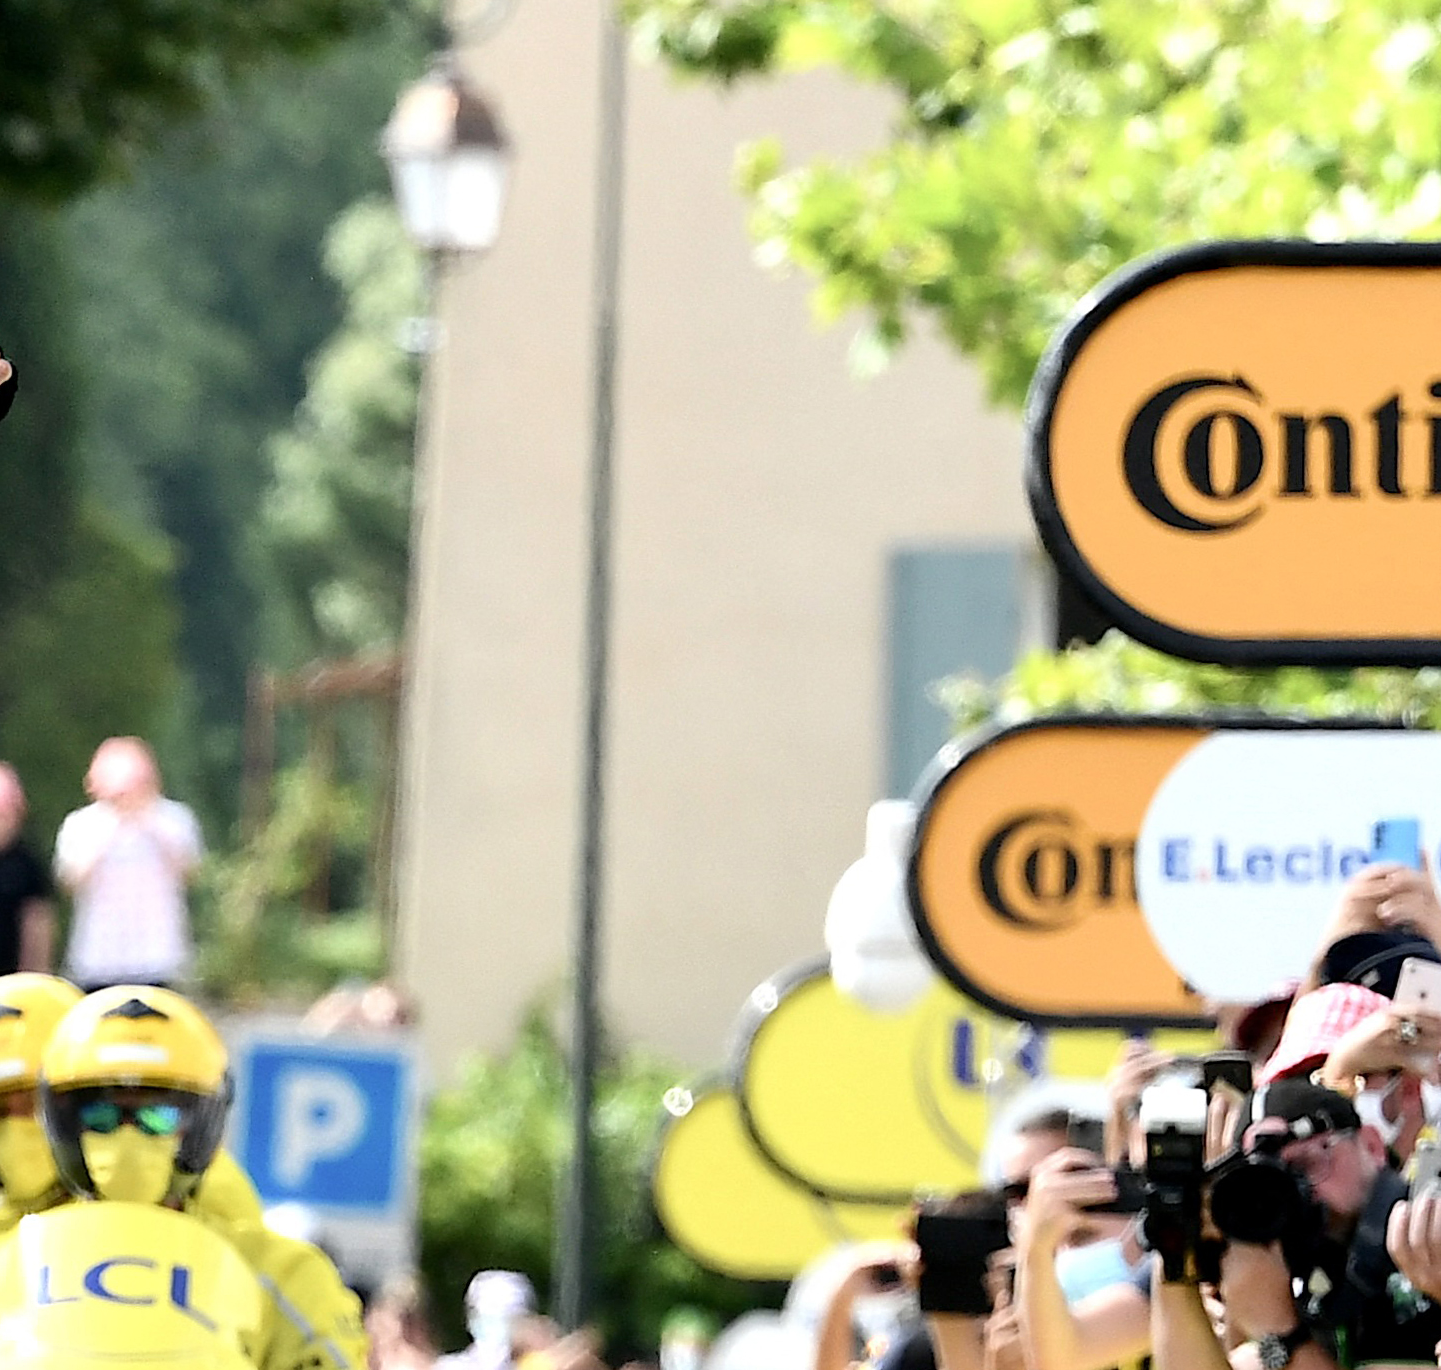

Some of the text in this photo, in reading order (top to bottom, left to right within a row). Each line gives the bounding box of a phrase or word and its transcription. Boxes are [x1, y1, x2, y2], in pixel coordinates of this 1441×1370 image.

[1160, 837, 1369, 884] E.Lecle
[273, 1062, 367, 1190] P
[37, 1256, 219, 1331] LCL
